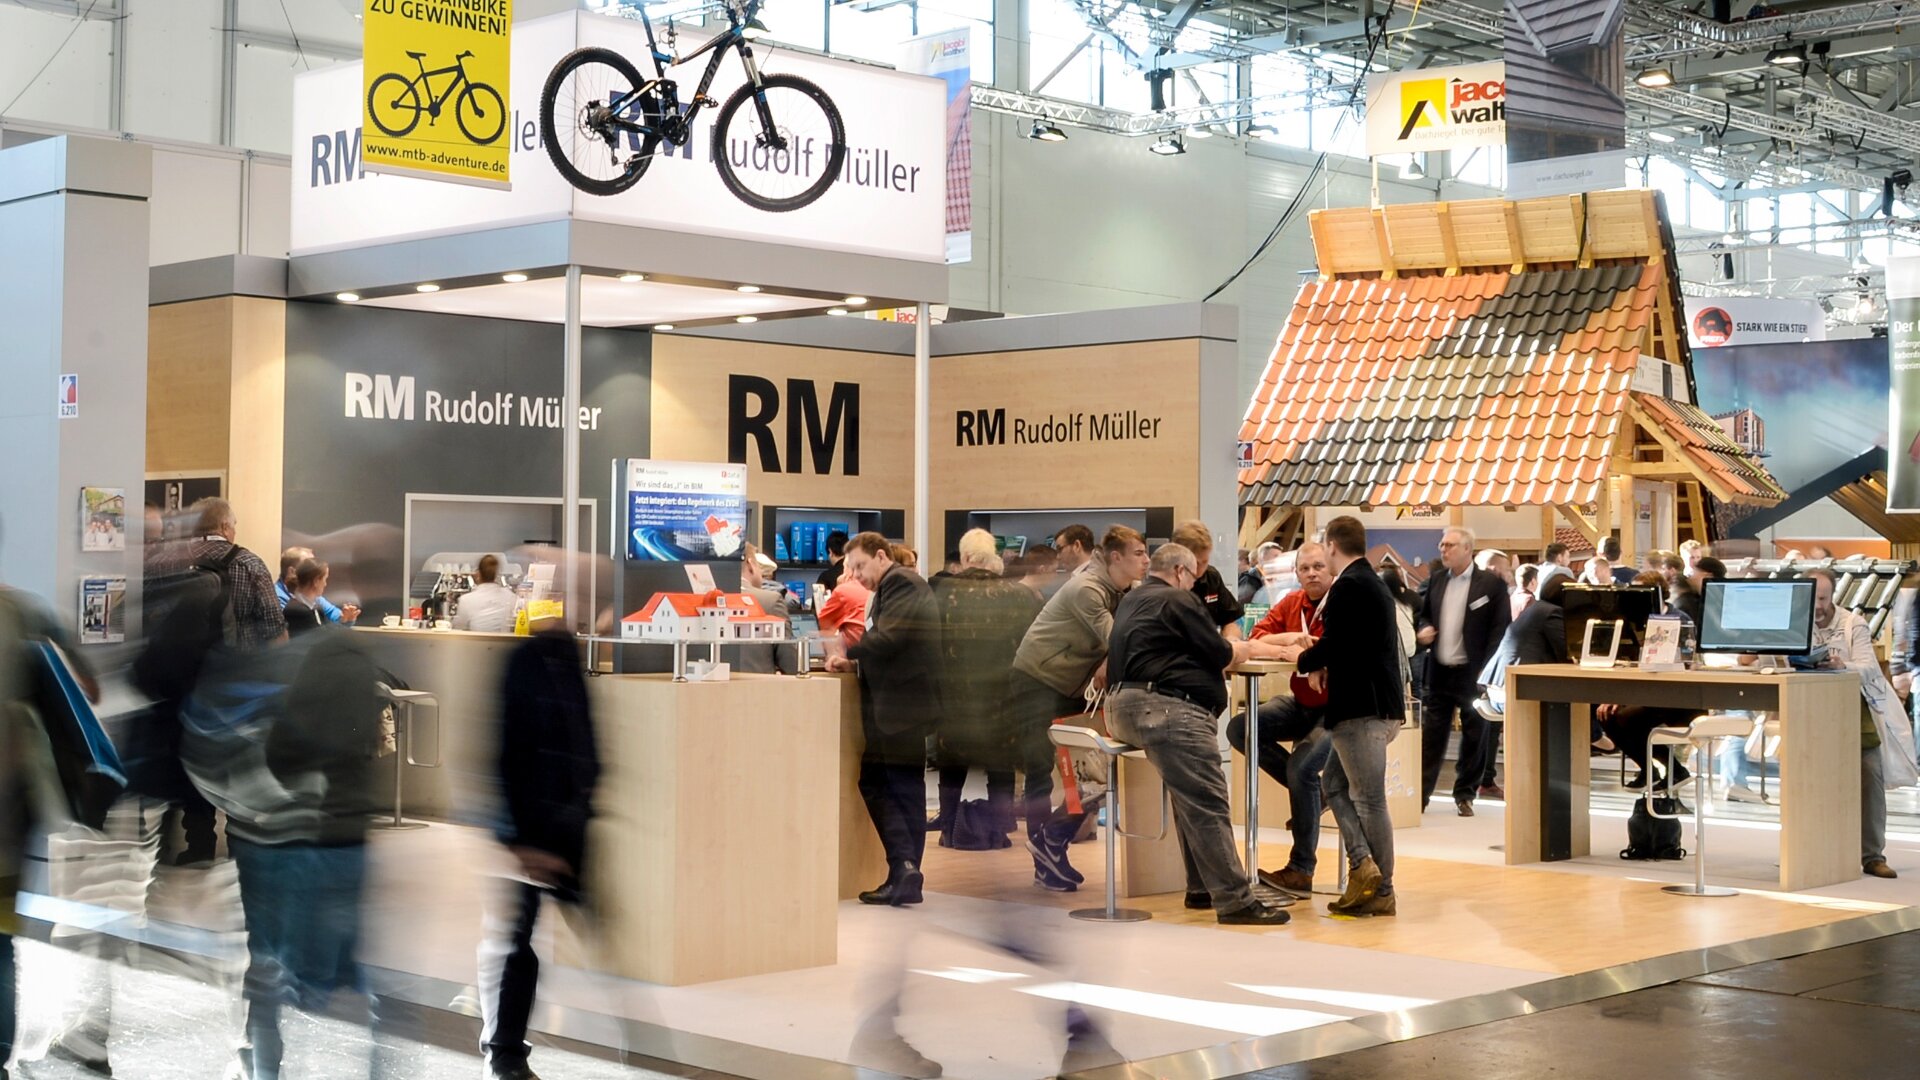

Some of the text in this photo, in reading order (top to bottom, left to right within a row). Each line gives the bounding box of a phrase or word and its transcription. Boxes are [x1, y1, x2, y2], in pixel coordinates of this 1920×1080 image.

[370, 0, 506, 36] ZU GEWINNEN!
[311, 127, 365, 188] RM
[366, 143, 506, 174] www.mtb-adventure.de
[1736, 322, 1762, 332] STARK
[1763, 322, 1778, 333] WIE
[1779, 322, 1790, 333] EIN
[1894, 320, 1915, 333] Der
[344, 372, 602, 431] RM Rudolf Müer
[728, 373, 860, 477] RM
[956, 407, 1162, 447] RM Rudolf Müller
[648, 481, 661, 489] sind
[691, 482, 703, 490] BIM
